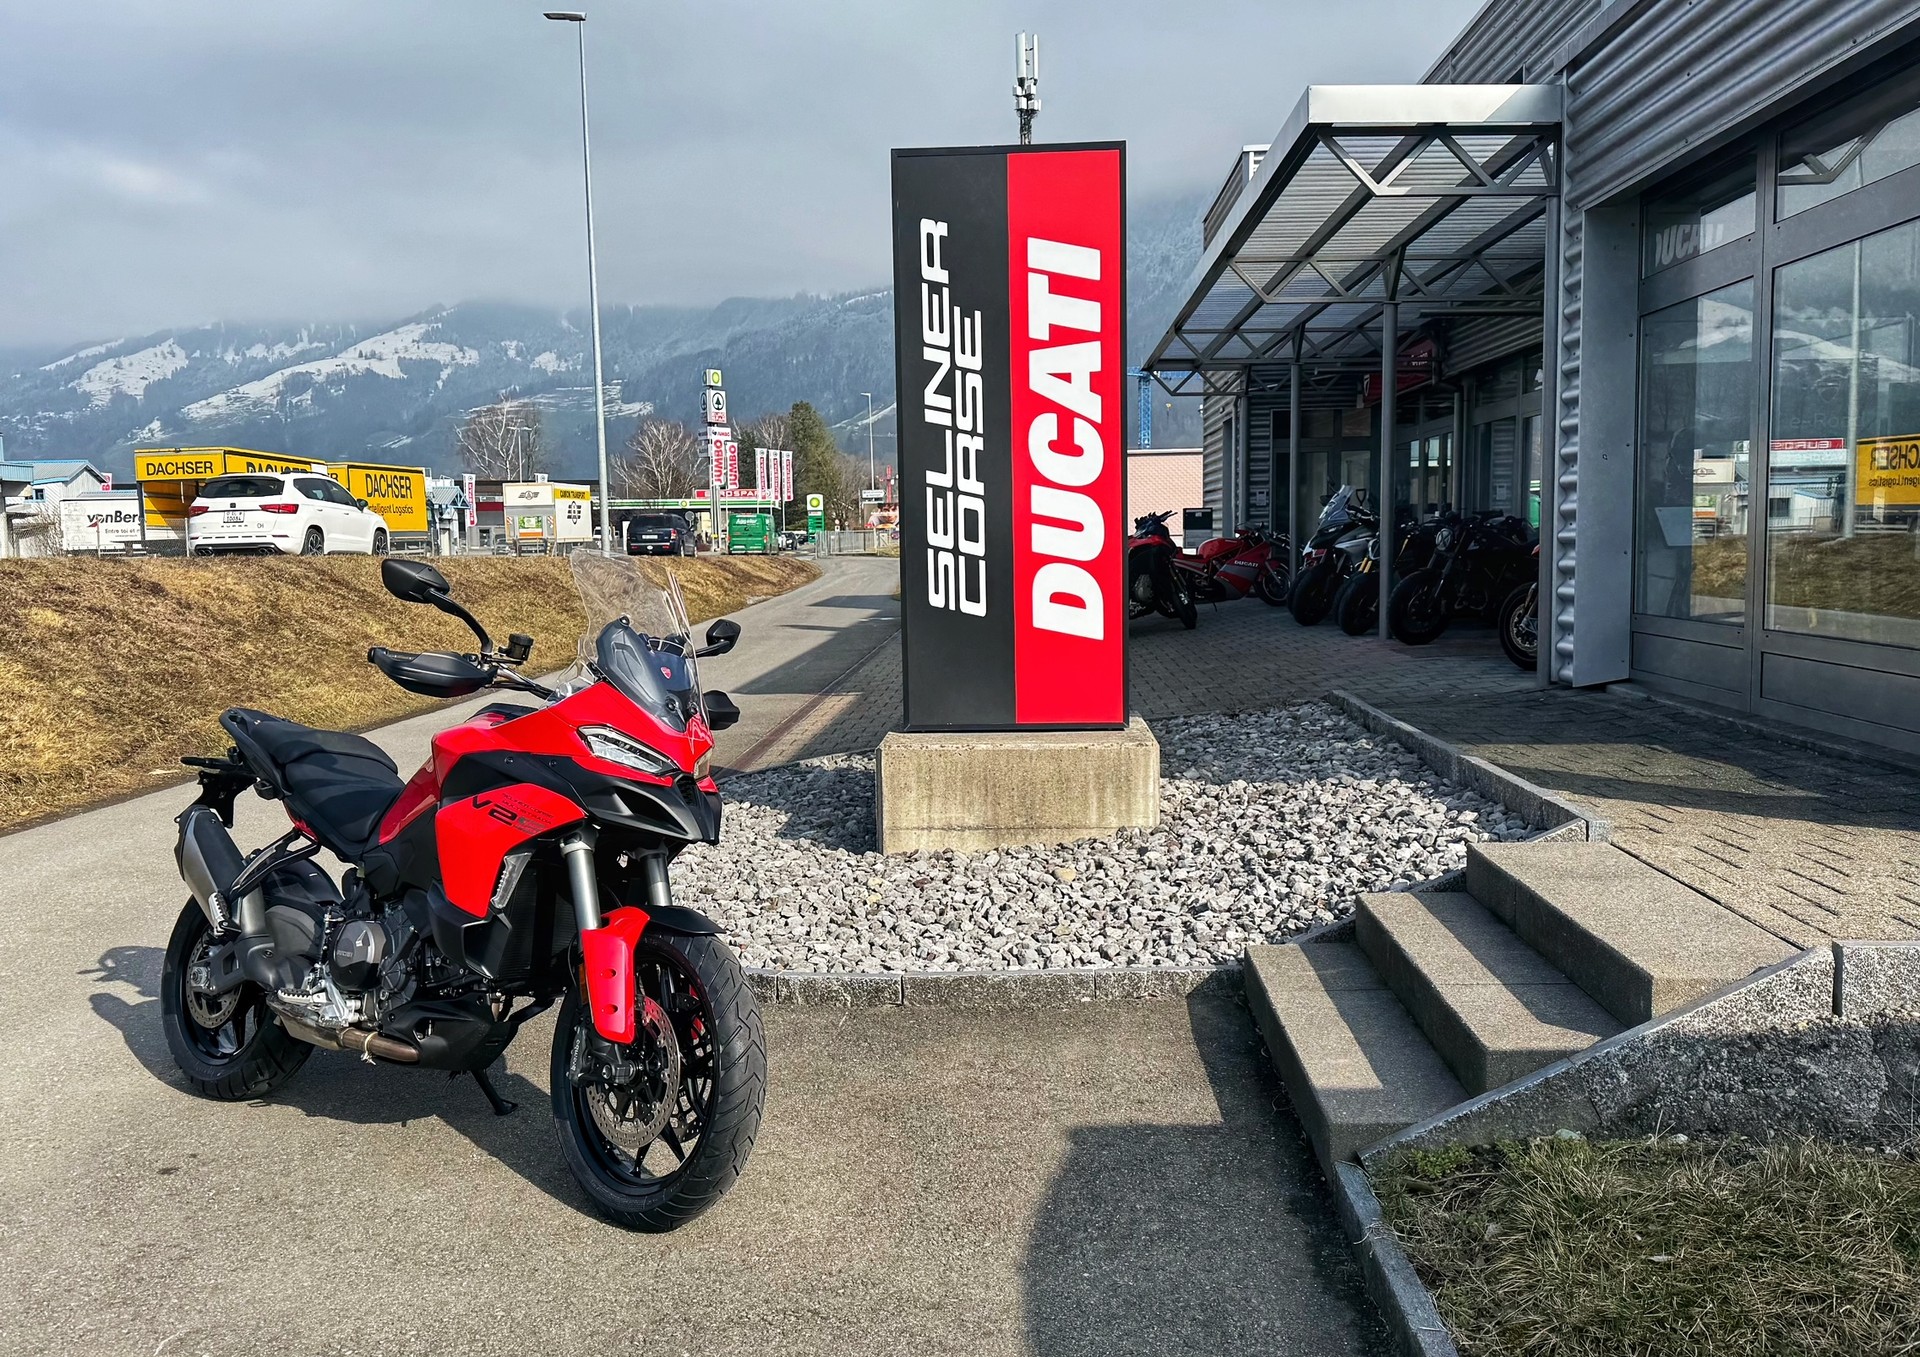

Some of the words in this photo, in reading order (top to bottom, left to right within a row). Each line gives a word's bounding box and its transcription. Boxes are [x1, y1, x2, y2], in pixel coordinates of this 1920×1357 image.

[919, 217, 957, 611] SELINER
[1026, 236, 1106, 641] DUCATI
[146, 461, 214, 476] DACHSER
[713, 439, 723, 484] JUMBO
[728, 444, 738, 488] JUMBO
[953, 305, 988, 618] CORSE
[365, 473, 413, 499] DACHSER
[87, 510, 141, 526] vonBer
[368, 503, 392, 516] ntelligent
[392, 503, 414, 516] Logistics
[1234, 560, 1259, 568] DUCATI
[570, 1039, 581, 1071] brembo
